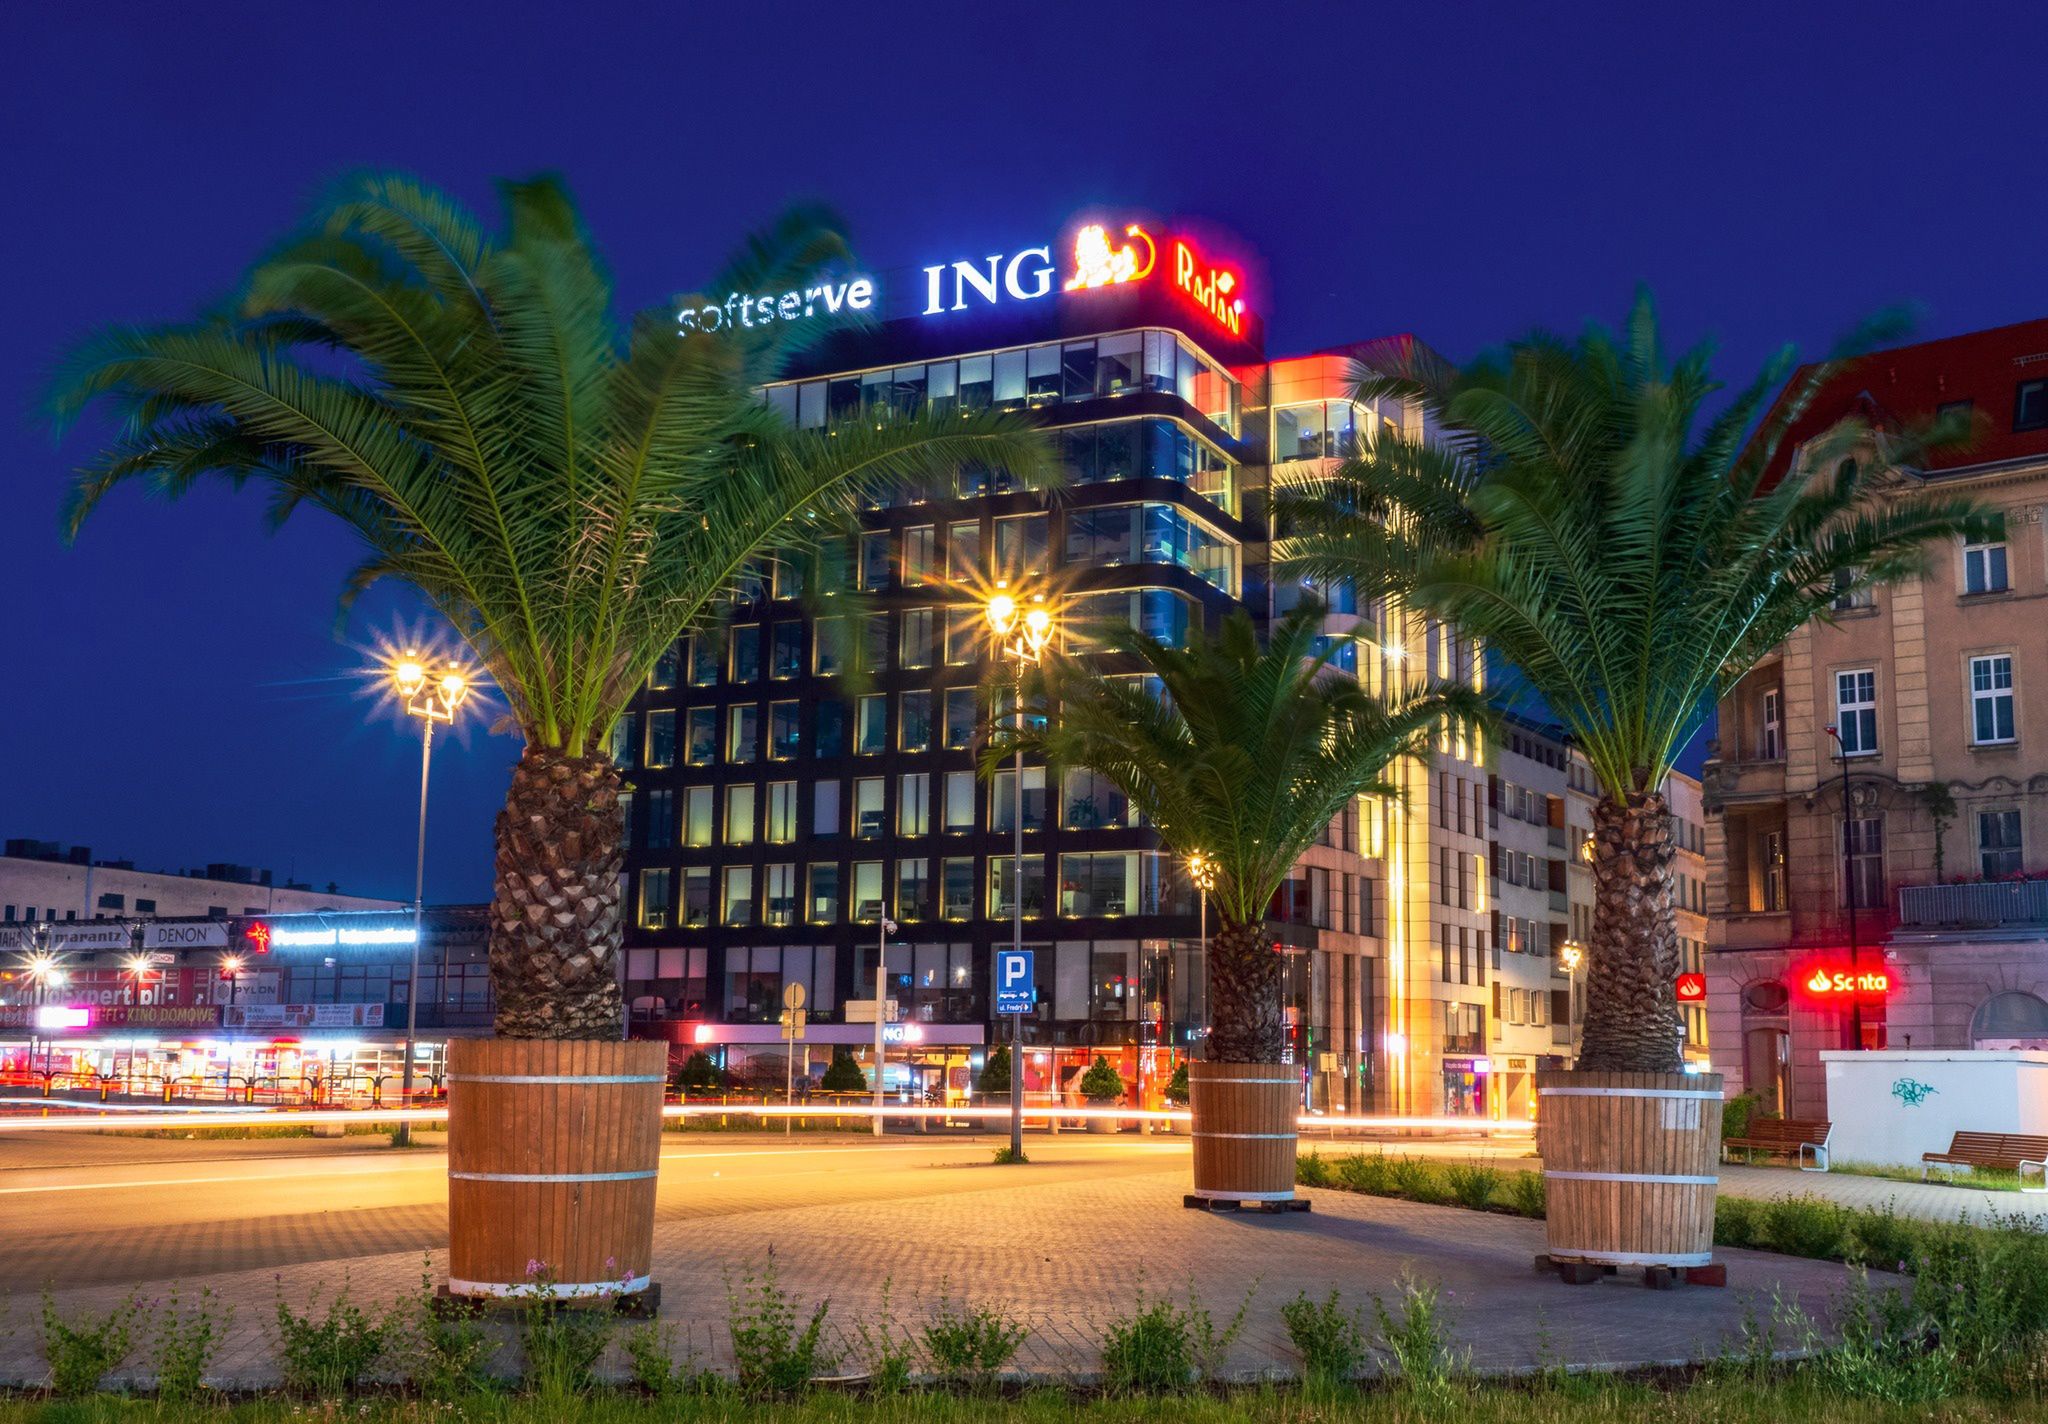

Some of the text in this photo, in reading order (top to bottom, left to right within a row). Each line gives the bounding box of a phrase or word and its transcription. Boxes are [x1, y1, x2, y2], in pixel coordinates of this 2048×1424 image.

[922, 245, 1055, 315] ING
[677, 279, 872, 338] softserve
[54, 930, 122, 944] marantz
[158, 927, 208, 944] DENON
[1006, 956, 1026, 987] P
[127, 1007, 157, 1022] KINO
[161, 1007, 215, 1023] DOMOWE
